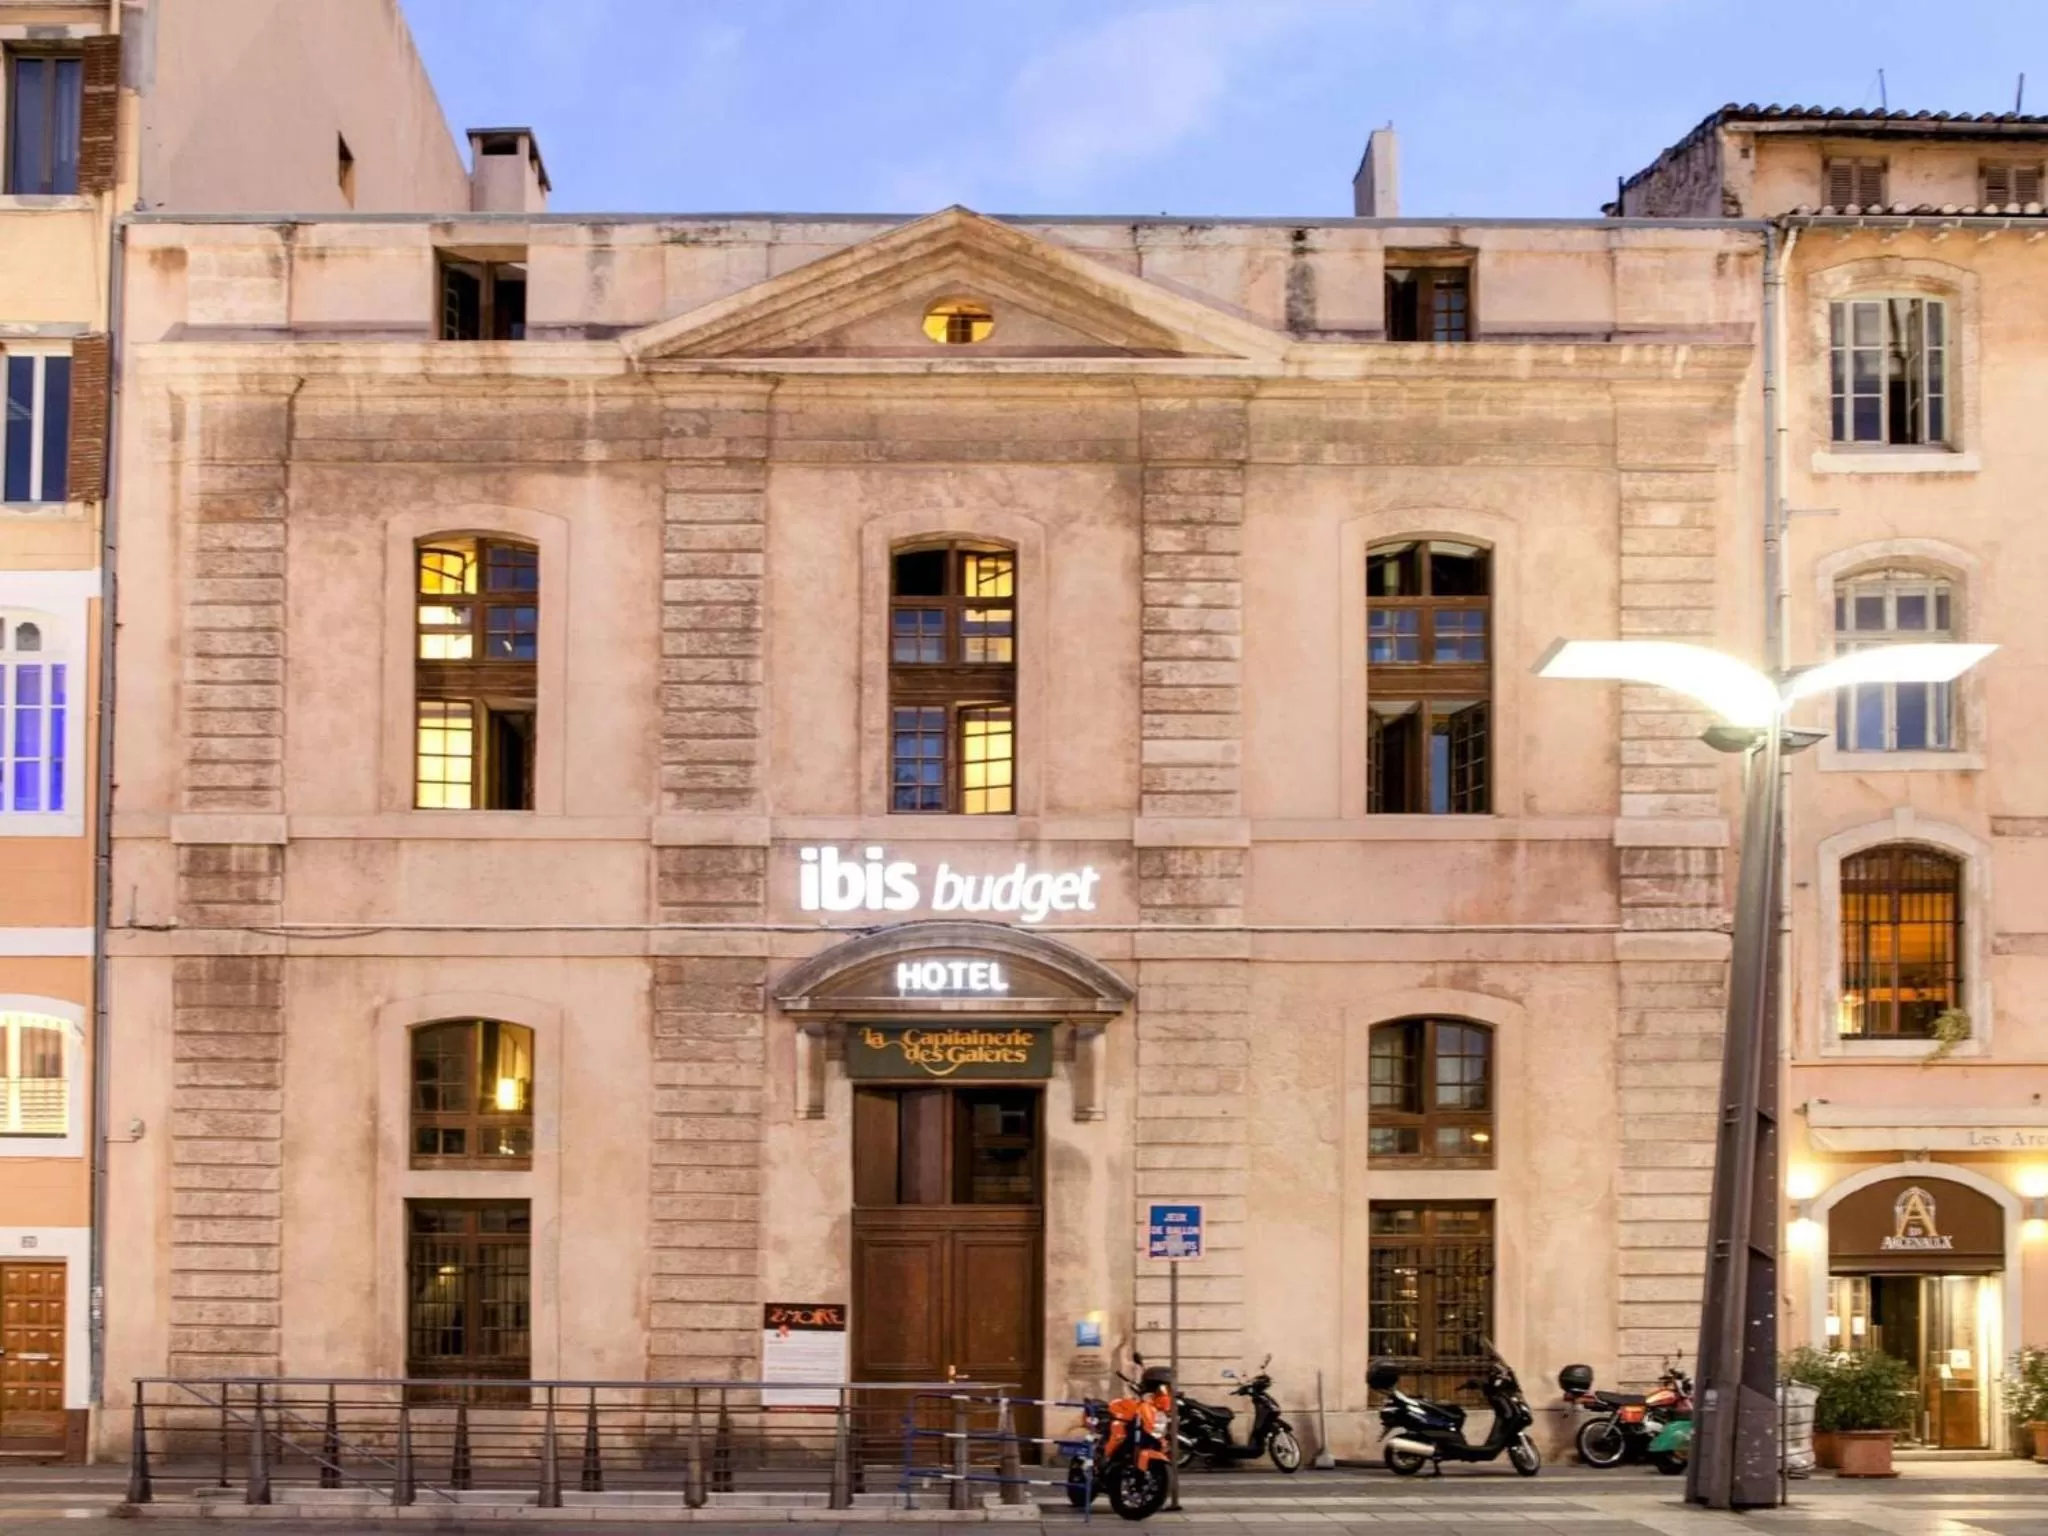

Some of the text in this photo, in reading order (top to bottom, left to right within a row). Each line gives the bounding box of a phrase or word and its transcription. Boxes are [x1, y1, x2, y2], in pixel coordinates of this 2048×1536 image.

[799, 845, 1100, 924] ibis budget
[896, 961, 1009, 992] HOTEL
